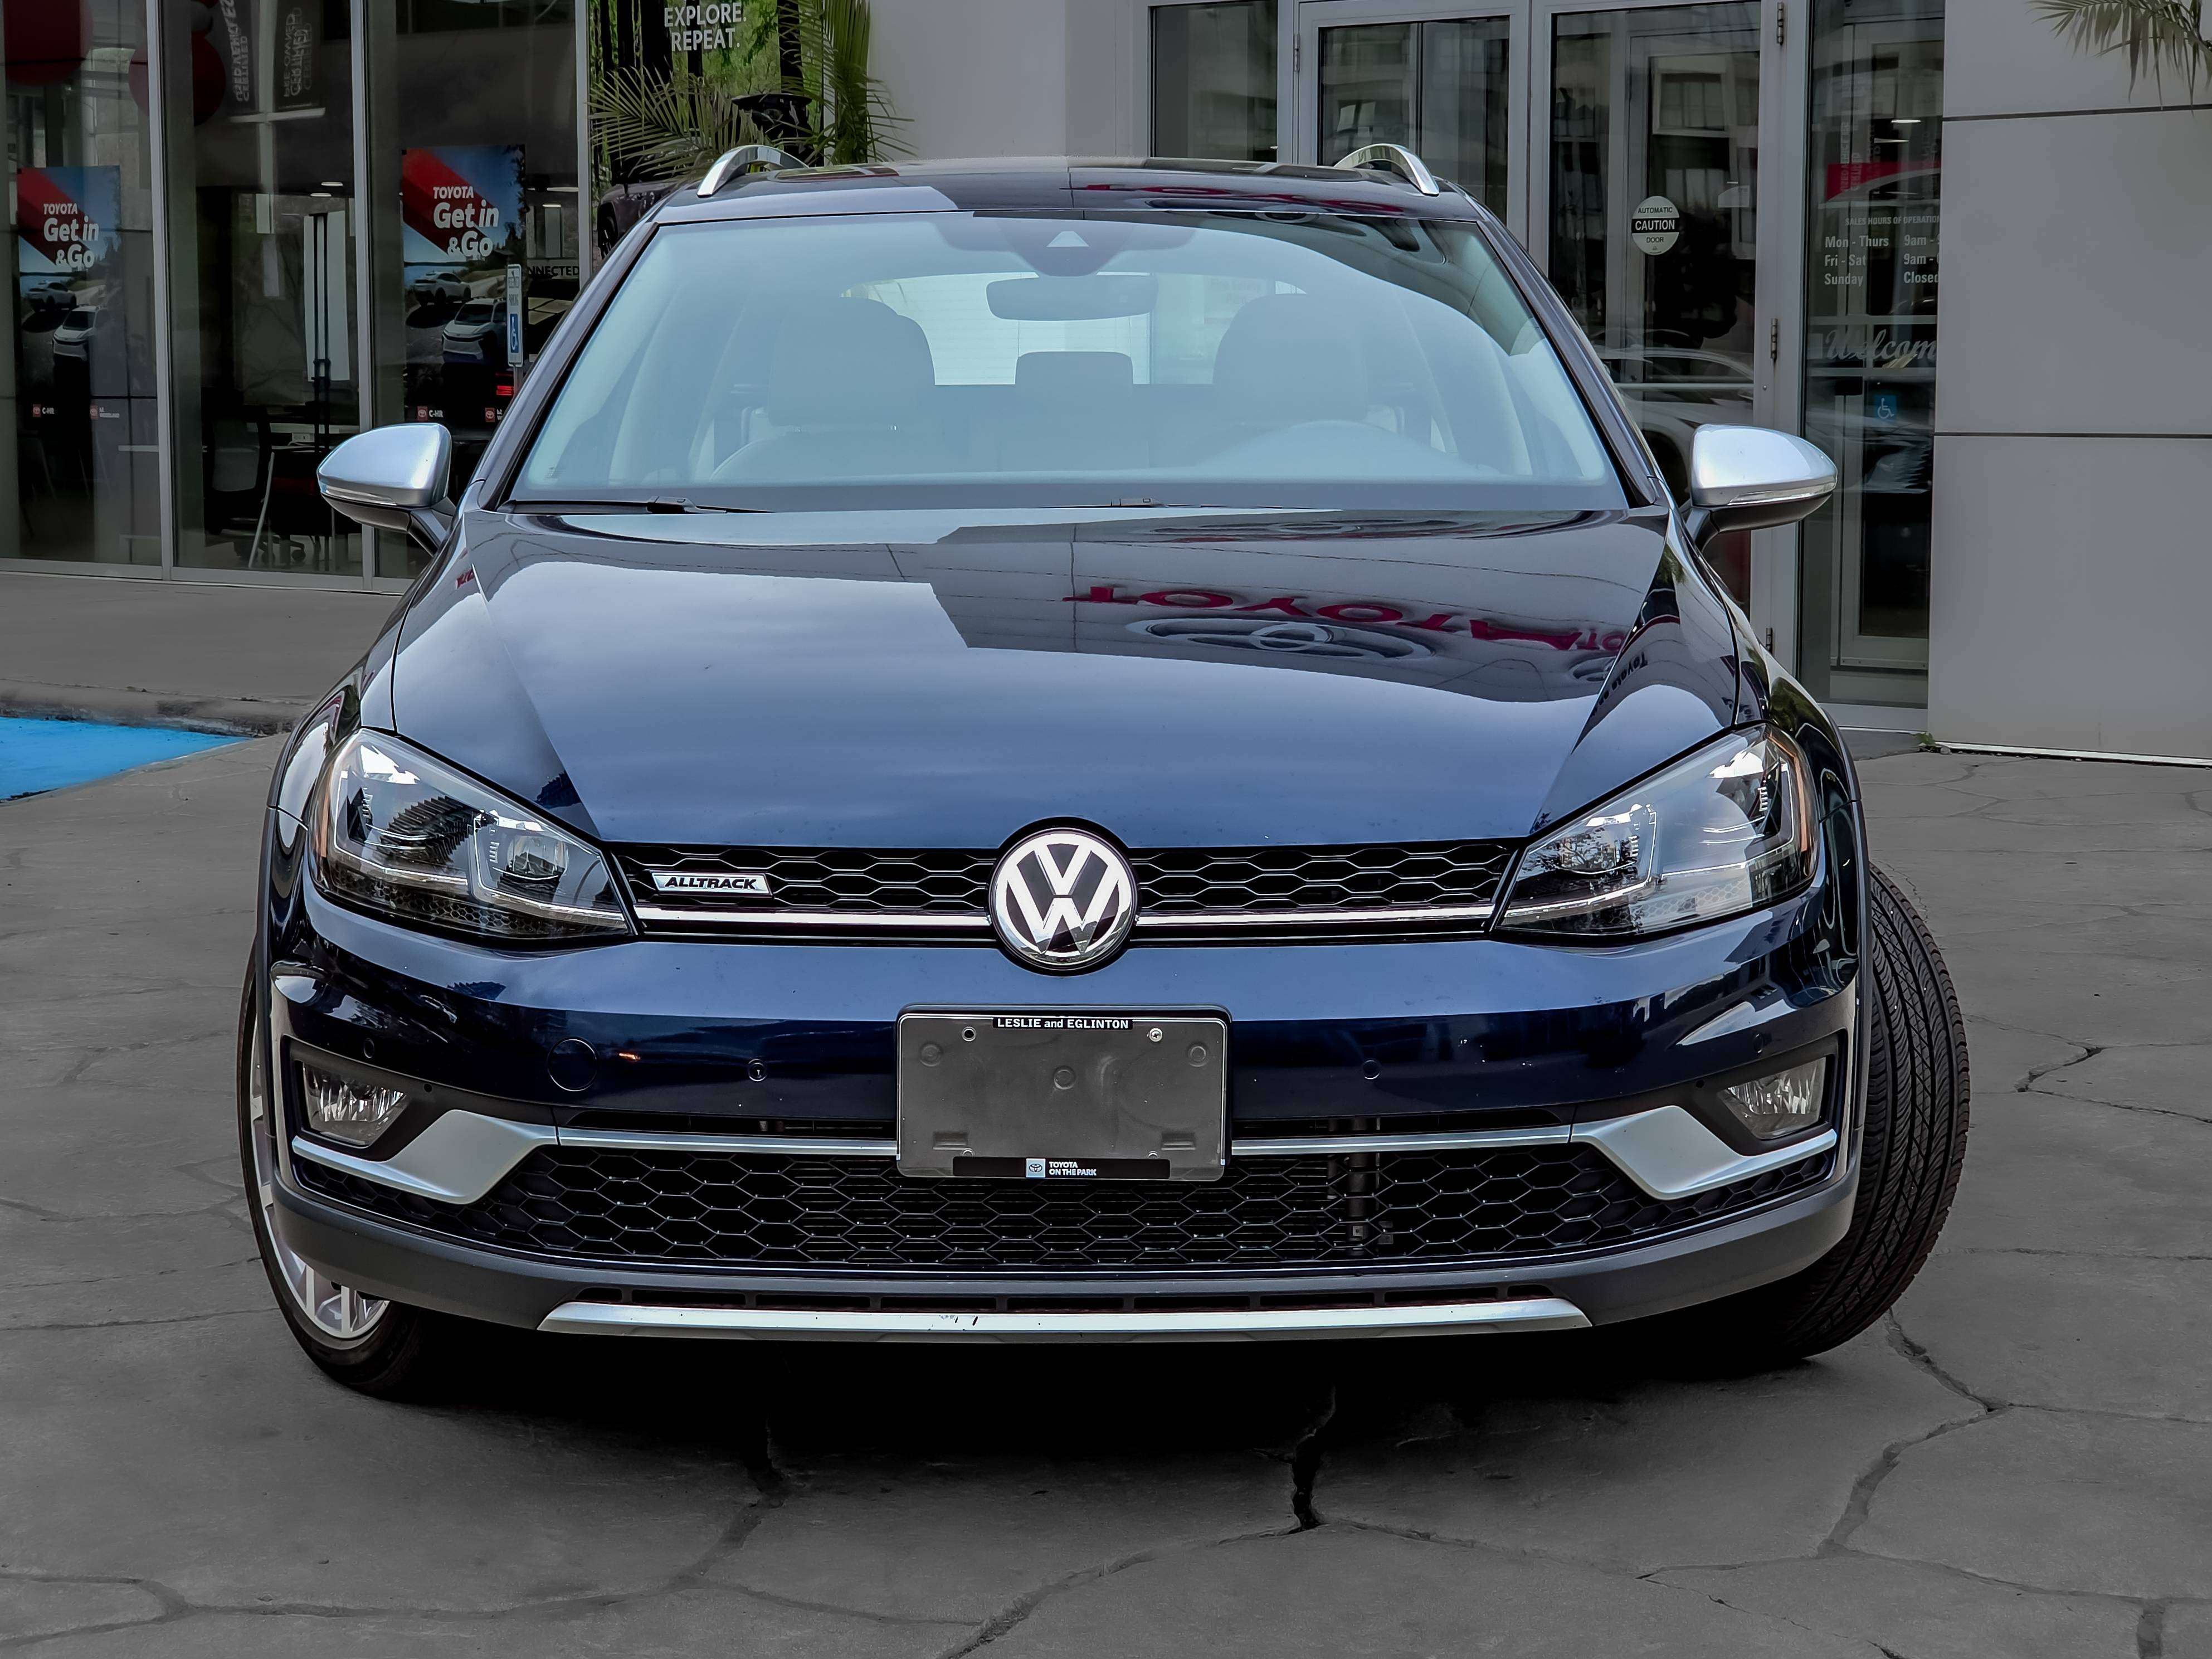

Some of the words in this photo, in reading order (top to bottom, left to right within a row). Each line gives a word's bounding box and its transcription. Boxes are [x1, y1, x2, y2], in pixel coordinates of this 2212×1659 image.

[664, 2, 747, 27] EXPLORE.
[671, 28, 740, 52] REPEAT.
[433, 186, 474, 199] TOYOTA
[43, 203, 78, 215] TOYOTA
[433, 202, 475, 228] Get
[479, 200, 499, 227] in
[1635, 220, 1675, 231] CAUTION
[1845, 217, 1866, 226] SALES
[44, 217, 79, 241] Get
[83, 216, 99, 241] in
[1825, 236, 1848, 247] Mon
[1859, 235, 1889, 247] Thurs
[1904, 234, 1926, 246] 9am
[1825, 255, 1838, 266] Fri
[1849, 254, 1866, 266] Sat
[1904, 254, 1926, 265] 9am
[528, 266, 579, 276] NNECTED
[1824, 273, 1864, 286] Sunday
[1825, 329, 1937, 360] Welcom
[665, 877, 757, 889] ALLTRACK
[997, 1018, 1041, 1028] LESLIE
[1044, 1019, 1063, 1028] and
[1067, 1019, 1129, 1029] EGLINTON
